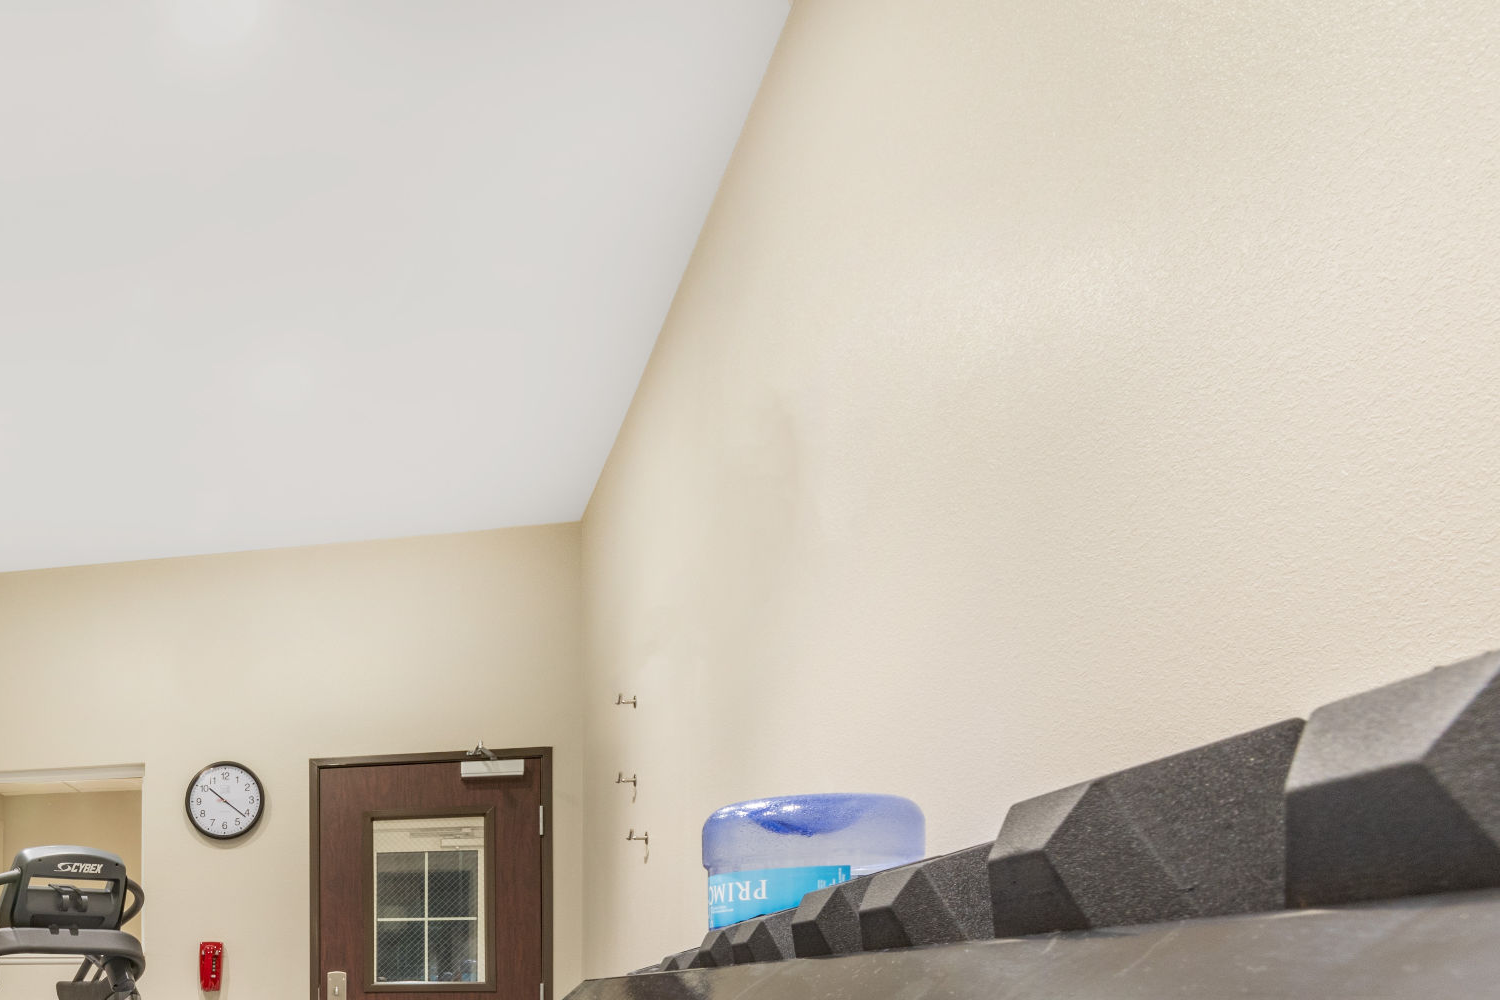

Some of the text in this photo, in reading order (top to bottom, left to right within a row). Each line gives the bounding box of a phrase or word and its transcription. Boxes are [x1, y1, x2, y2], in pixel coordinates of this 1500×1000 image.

[221, 771, 230, 781] 12
[200, 784, 209, 793] 10
[244, 783, 251, 792] 2
[196, 797, 202, 806] 9
[248, 795, 255, 804] 3
[199, 809, 206, 818] 8
[244, 808, 250, 817] 4
[209, 818, 216, 827] 7
[221, 821, 228, 830] 6
[234, 817, 241, 826] 5
[70, 862, 104, 874] CYBEX
